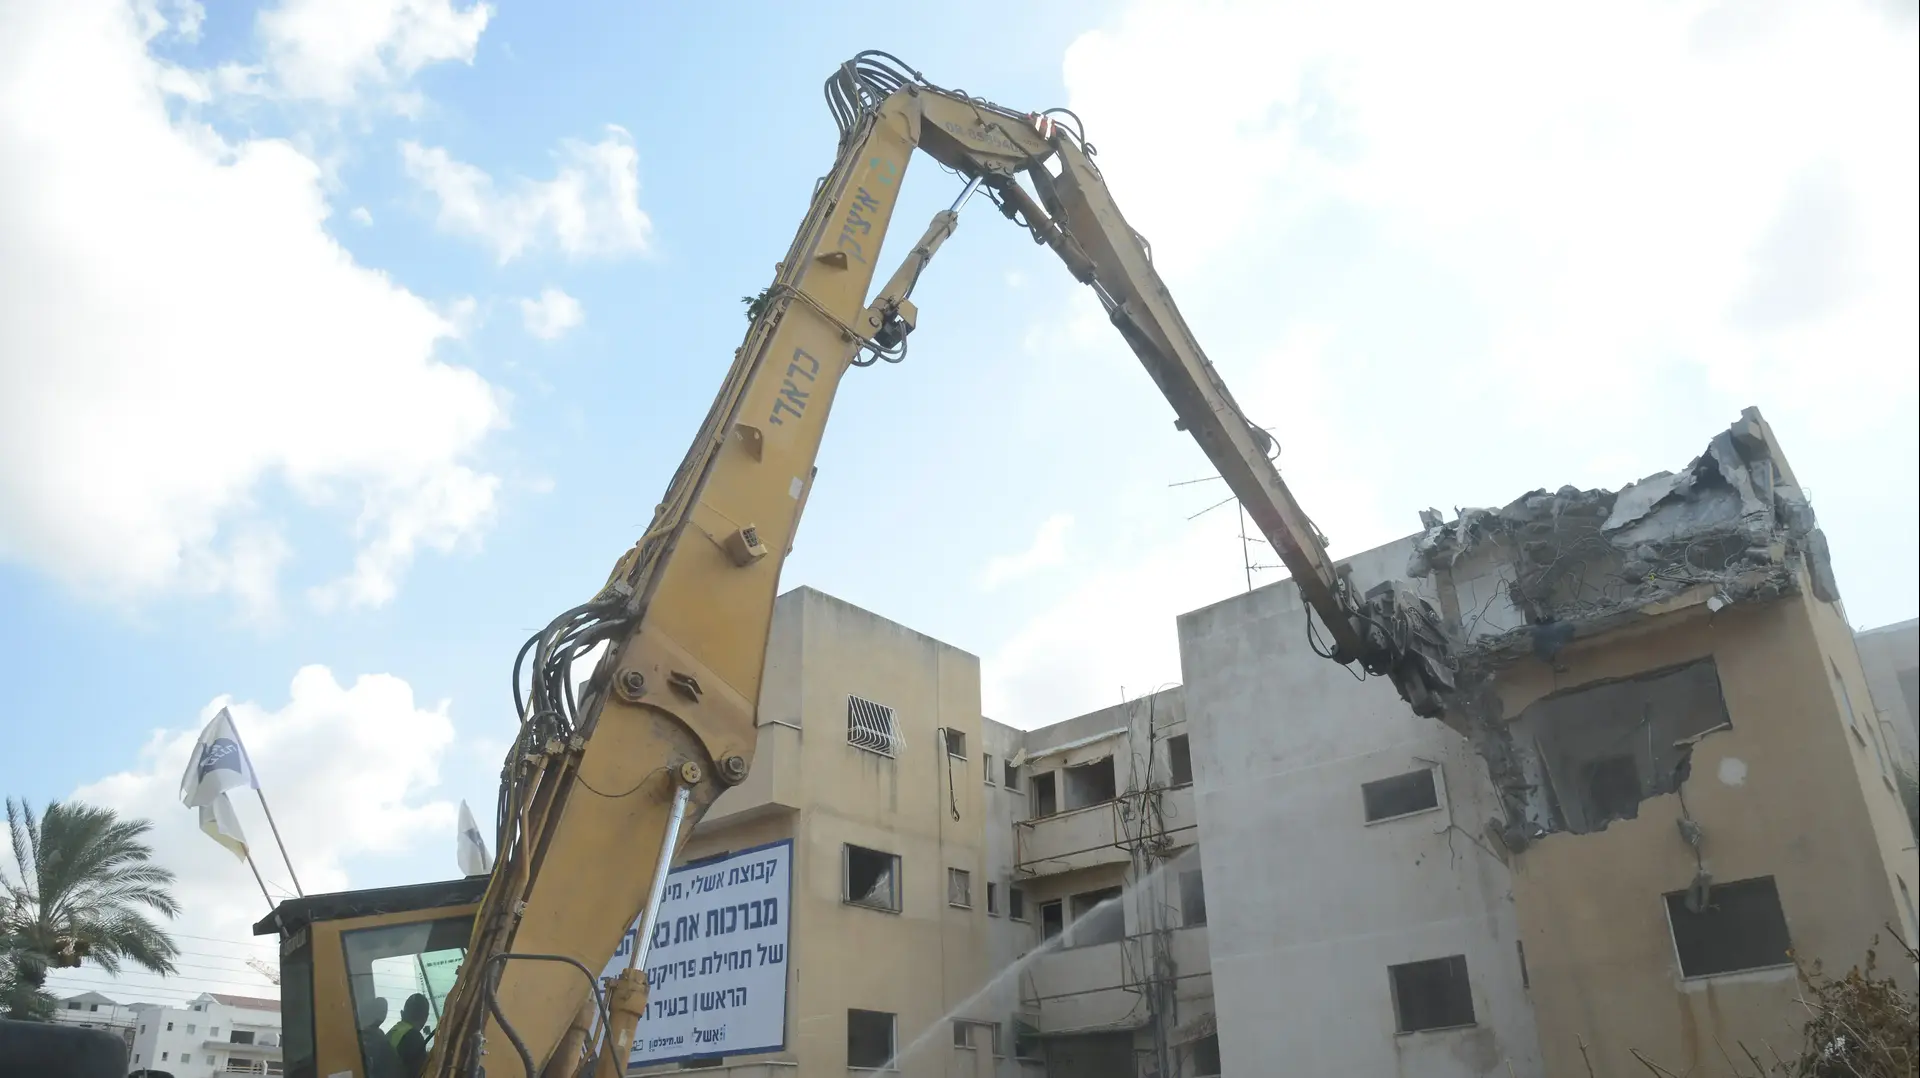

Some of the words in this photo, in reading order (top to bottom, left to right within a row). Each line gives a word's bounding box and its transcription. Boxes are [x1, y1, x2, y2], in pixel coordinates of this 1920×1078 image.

[728, 859, 777, 886] קבוצת
[674, 913, 700, 945] את
[705, 897, 778, 938] מברכות
[699, 949, 752, 976] תחילת
[757, 943, 783, 966] של
[654, 996, 688, 1018] בעיר
